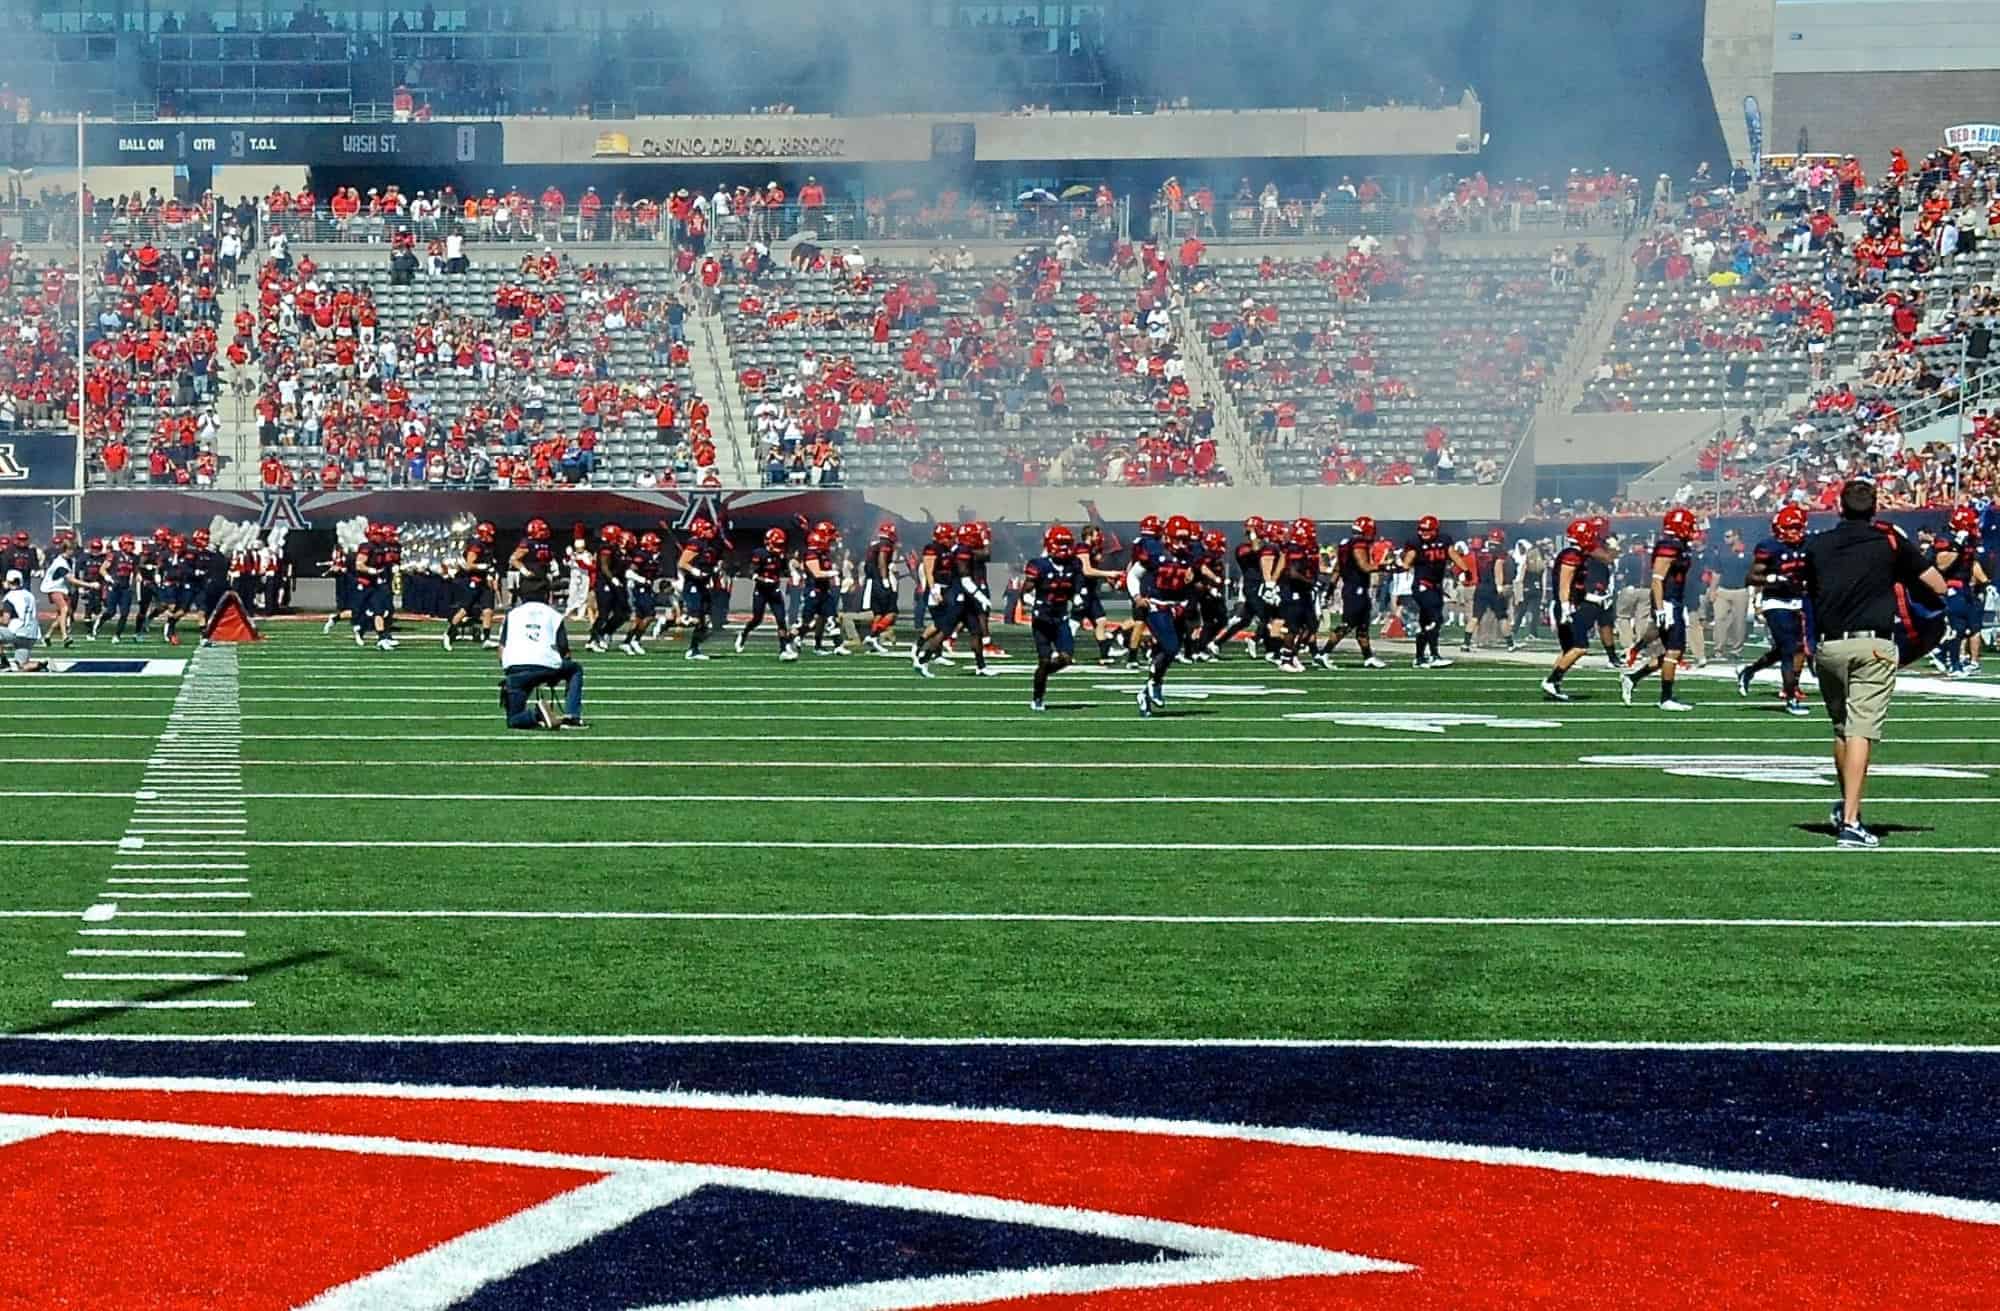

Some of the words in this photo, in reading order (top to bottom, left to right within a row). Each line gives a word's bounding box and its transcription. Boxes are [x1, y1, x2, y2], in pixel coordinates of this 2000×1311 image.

[1950, 128, 1968, 143] RED
[1979, 127, 2000, 142] BLU
[119, 138, 146, 151] BALL
[147, 138, 165, 151] ON
[193, 138, 216, 151] QTR
[342, 135, 377, 153] WASH
[380, 135, 400, 153] ST.
[640, 136, 706, 154] CASINO
[710, 136, 741, 154] DEL
[743, 136, 776, 154] SOL
